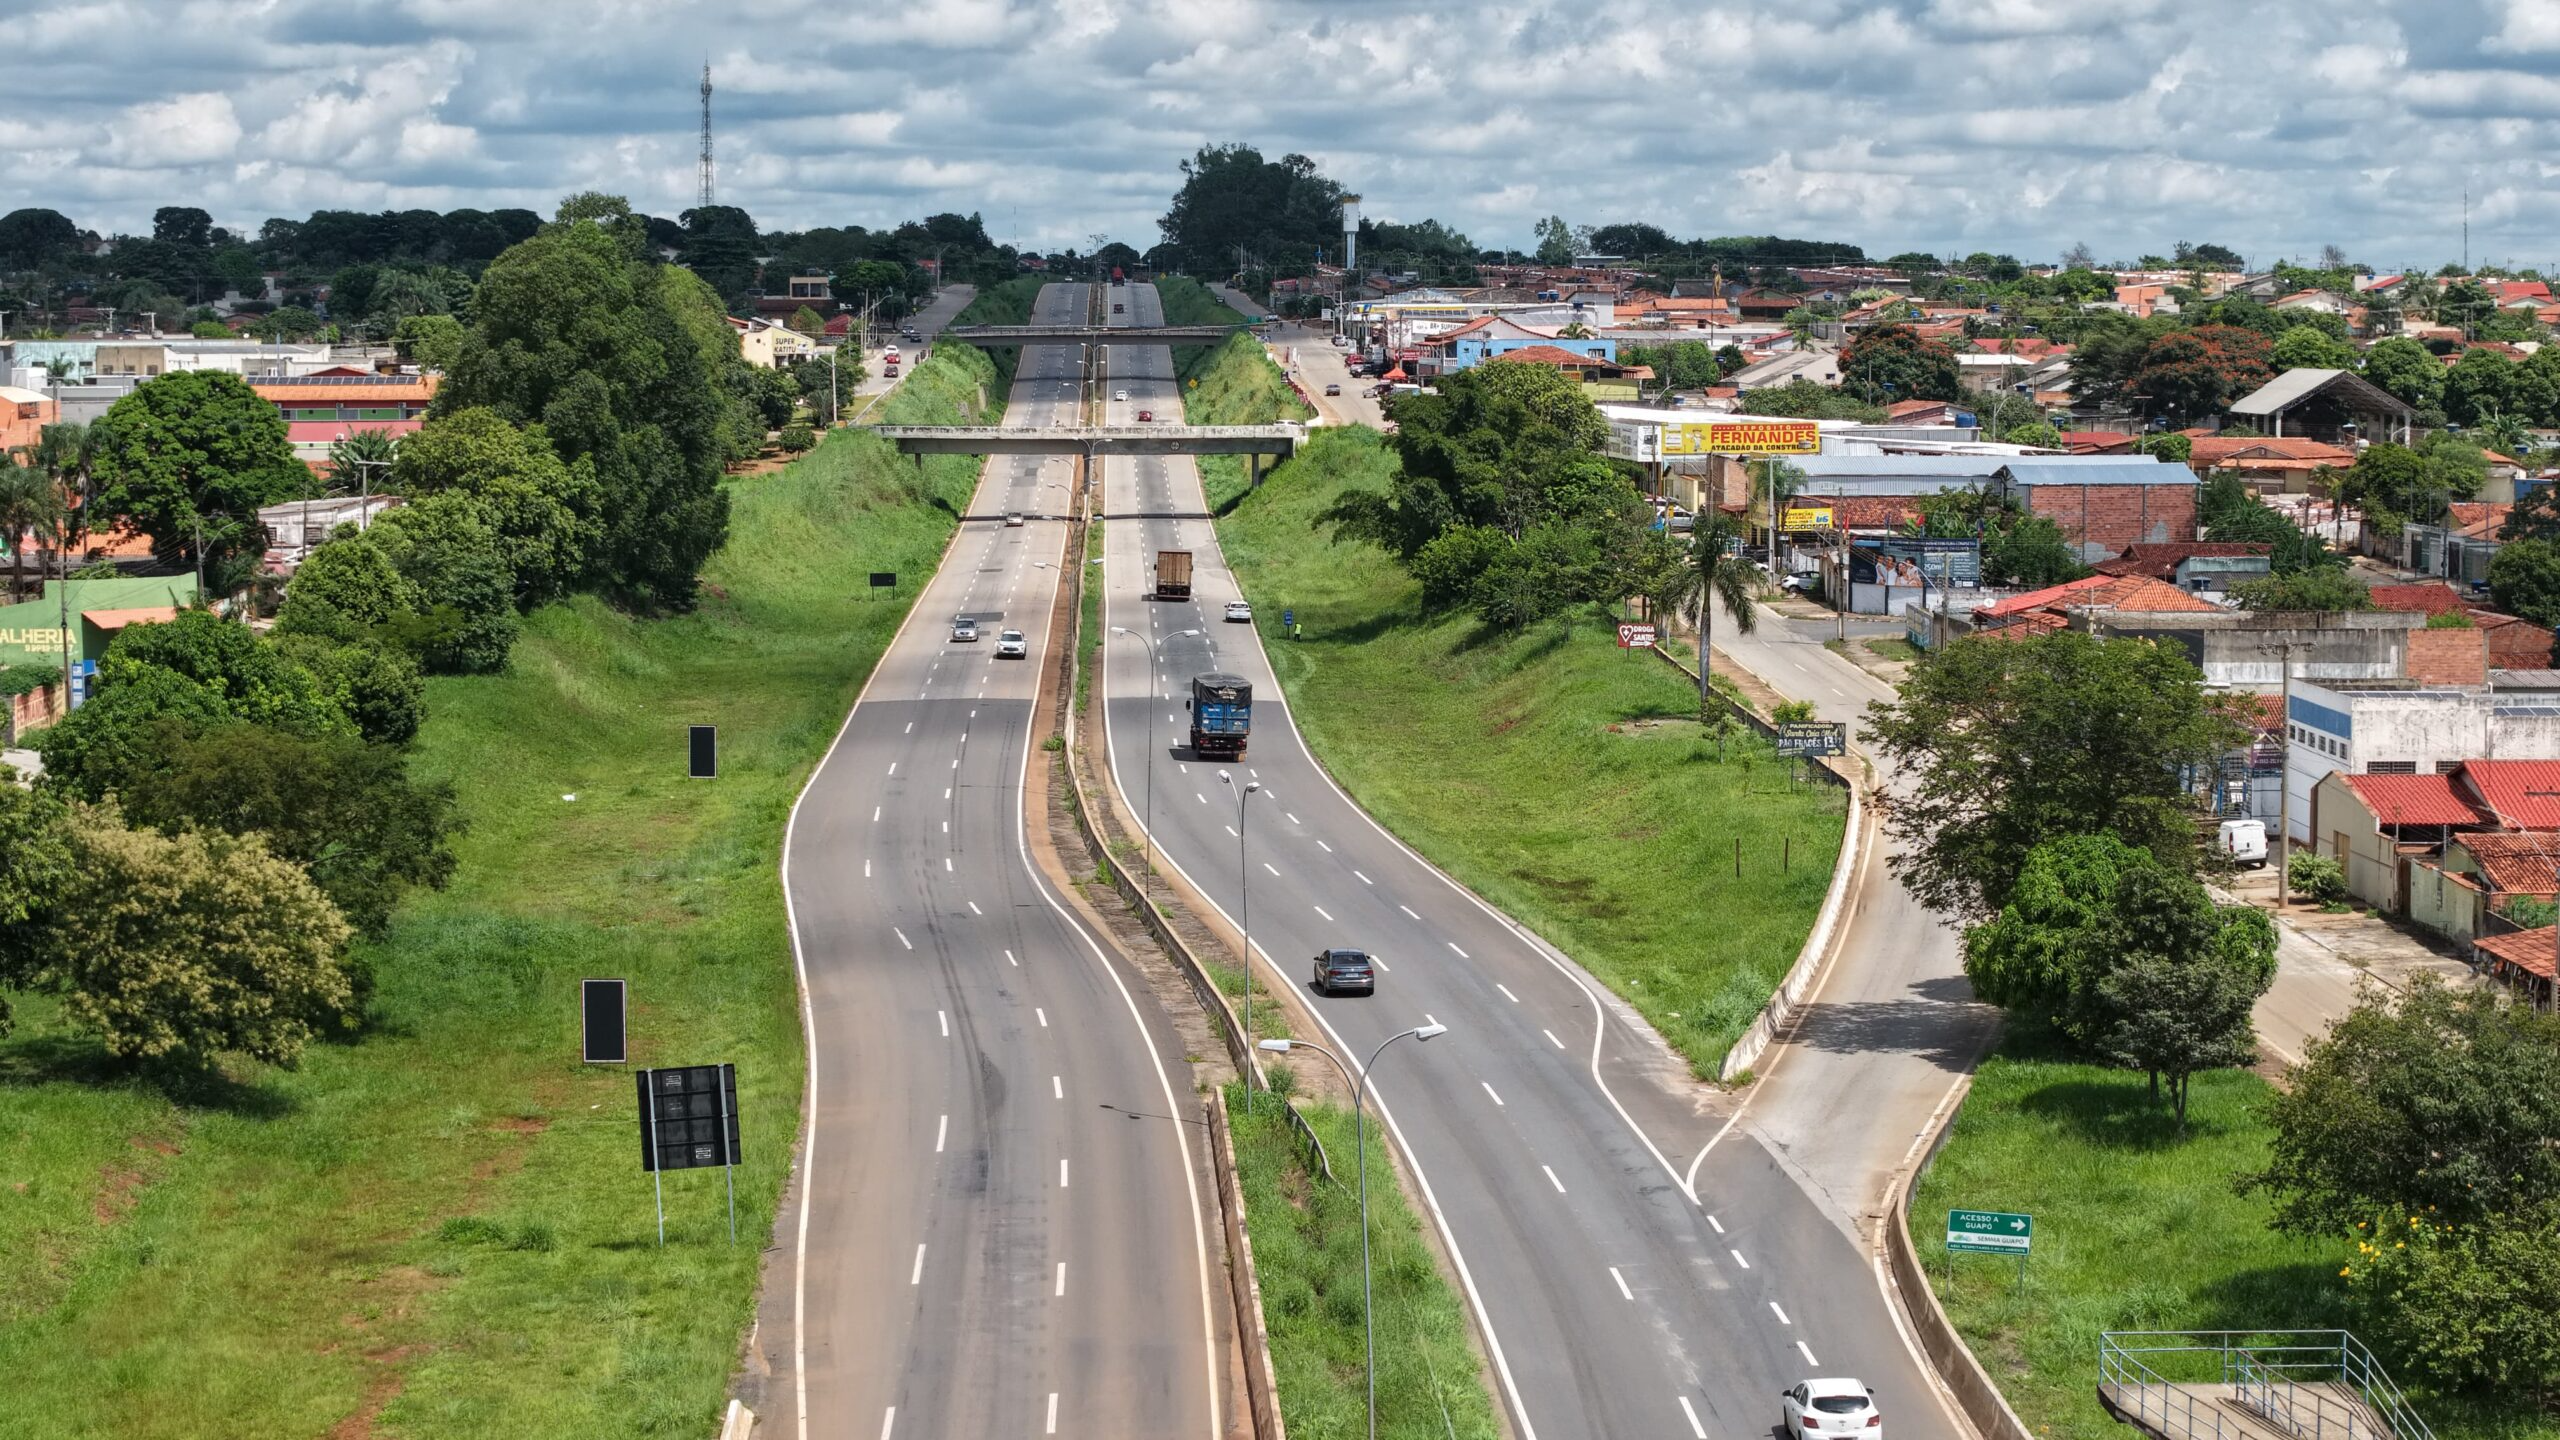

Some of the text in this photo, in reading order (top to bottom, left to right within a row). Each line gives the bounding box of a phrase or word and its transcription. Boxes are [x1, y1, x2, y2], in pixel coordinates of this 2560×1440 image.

[775, 337, 795, 345] SUPER
[1711, 430, 1816, 444] FERNANDES
[1633, 625, 1655, 633] DROGA
[1632, 633, 1655, 641] SANTOS
[1959, 1214, 1992, 1222] ACESSO
